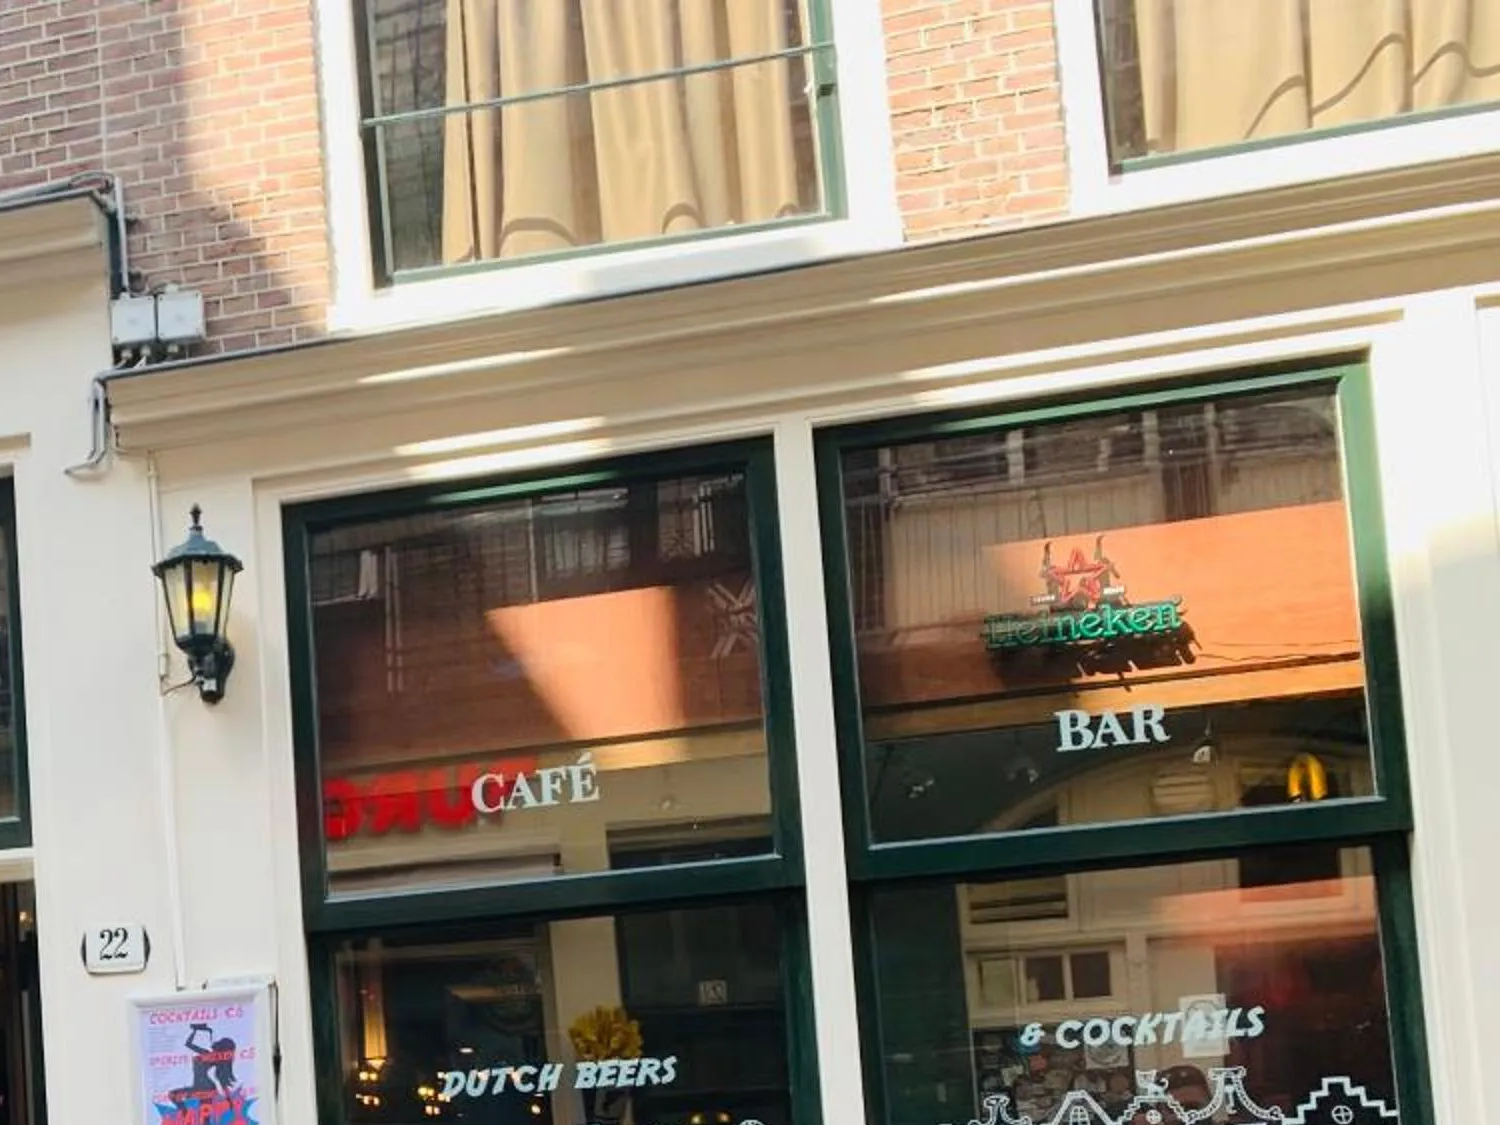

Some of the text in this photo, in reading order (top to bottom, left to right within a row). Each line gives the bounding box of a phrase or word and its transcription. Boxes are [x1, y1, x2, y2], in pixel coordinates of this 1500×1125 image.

[984, 600, 1184, 648] Heineken
[1053, 704, 1172, 752] BAR
[471, 752, 599, 813] CAFÉ
[100, 927, 129, 961] 22
[150, 1008, 218, 1025] COCKTAILS
[1019, 1006, 1266, 1049] & COCKTAILS
[442, 1055, 678, 1099] DUTCH BEERS
